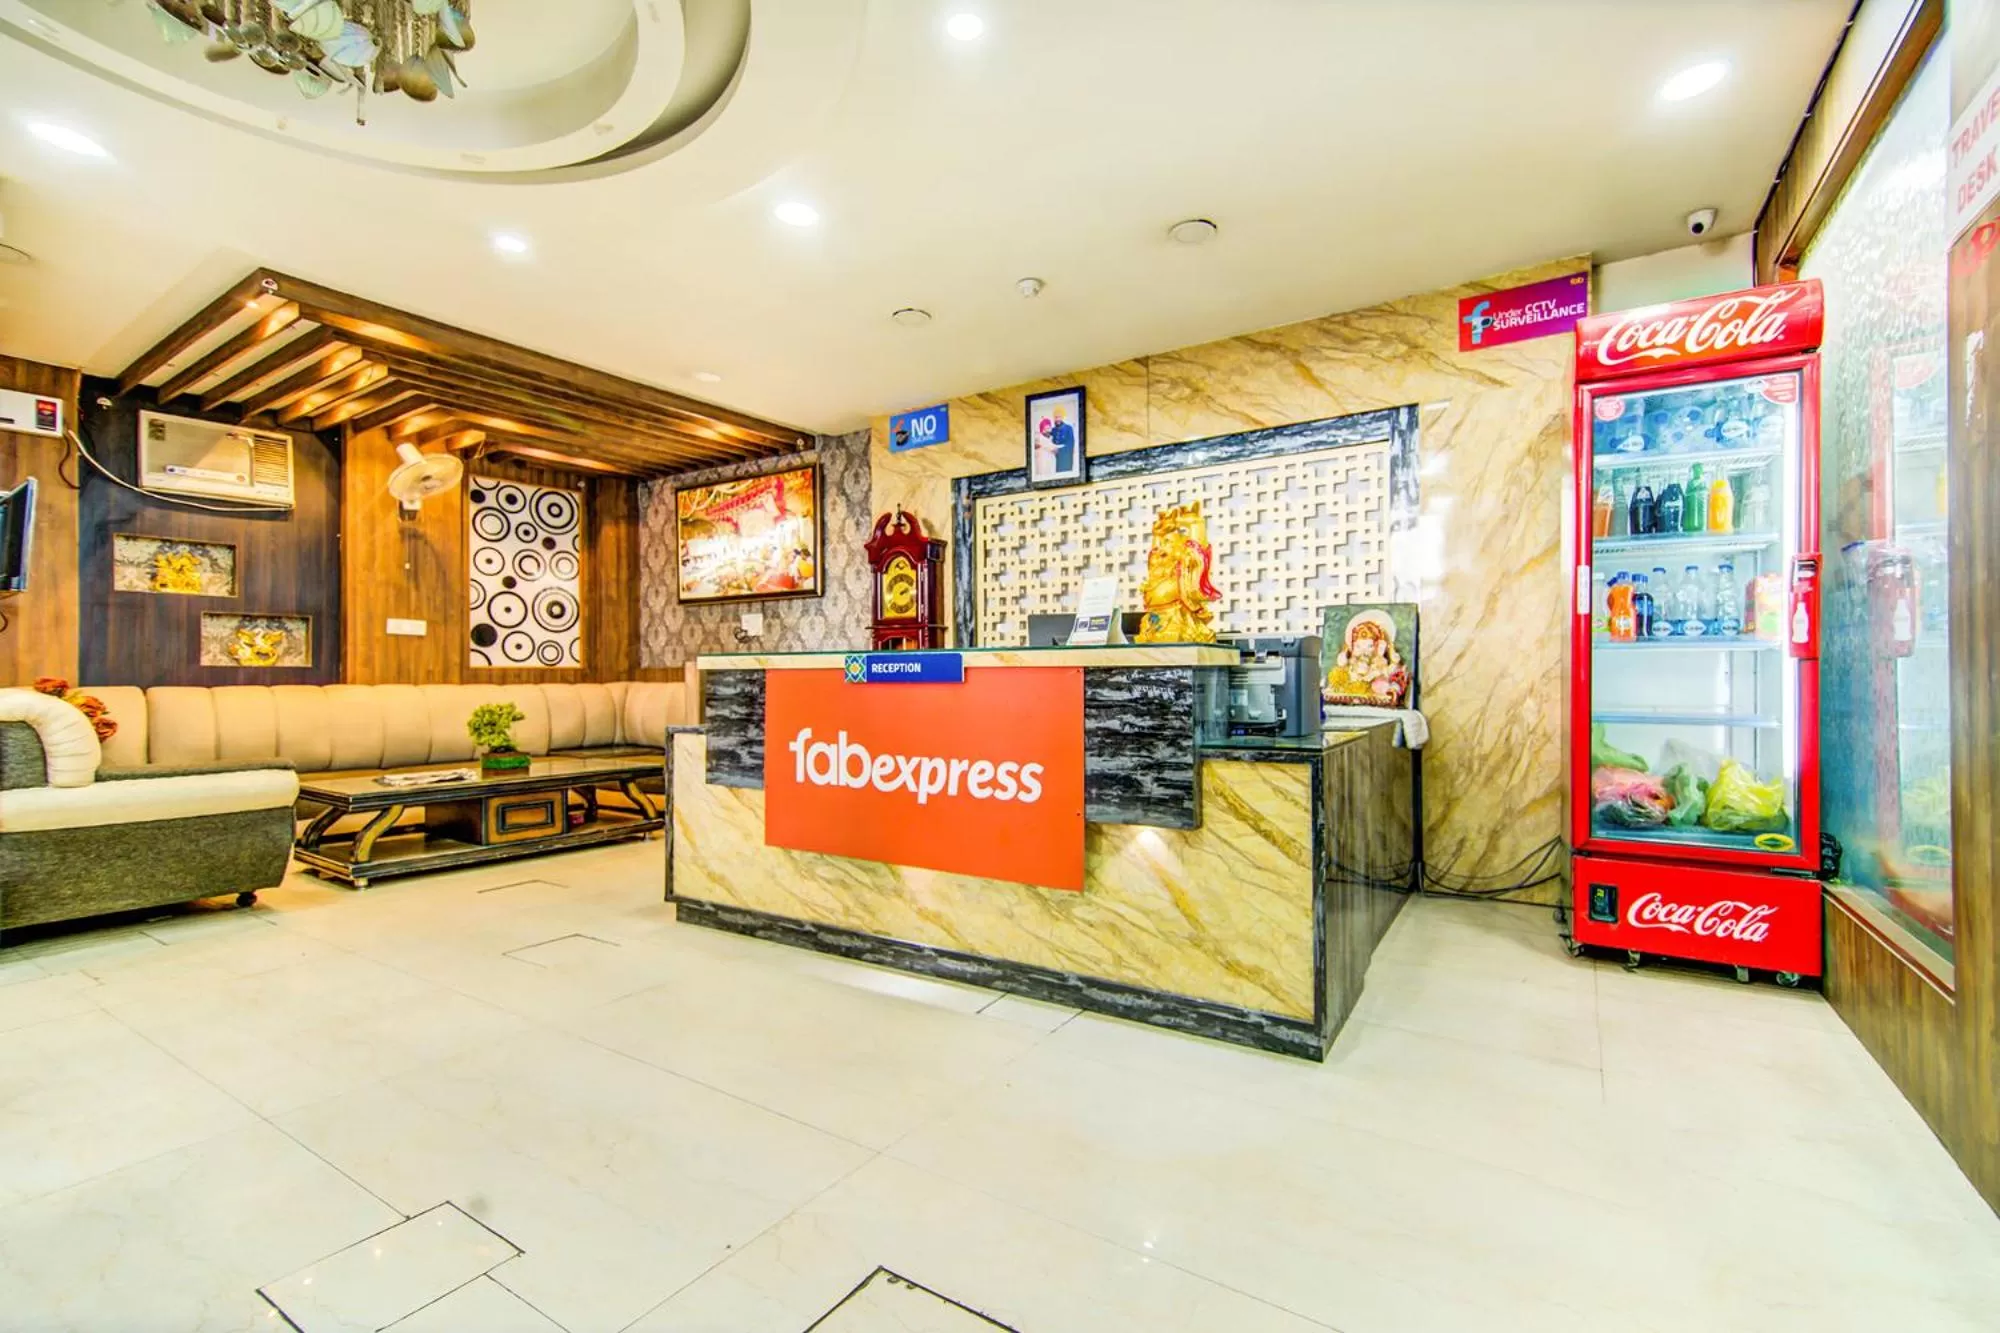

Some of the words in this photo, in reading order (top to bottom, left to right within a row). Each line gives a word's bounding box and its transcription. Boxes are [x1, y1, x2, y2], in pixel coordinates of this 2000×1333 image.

[1957, 144, 1998, 216] DESK
[1493, 308, 1522, 322] Under
[1525, 299, 1556, 314] CCTV
[1493, 302, 1585, 331] SURVEILLANCE
[1597, 286, 1799, 366] Coca-Cola
[911, 414, 936, 438] NO
[871, 663, 921, 674] RECEPTION
[789, 727, 1044, 804] fabexpress
[1627, 892, 1779, 943] Coca-Cola
